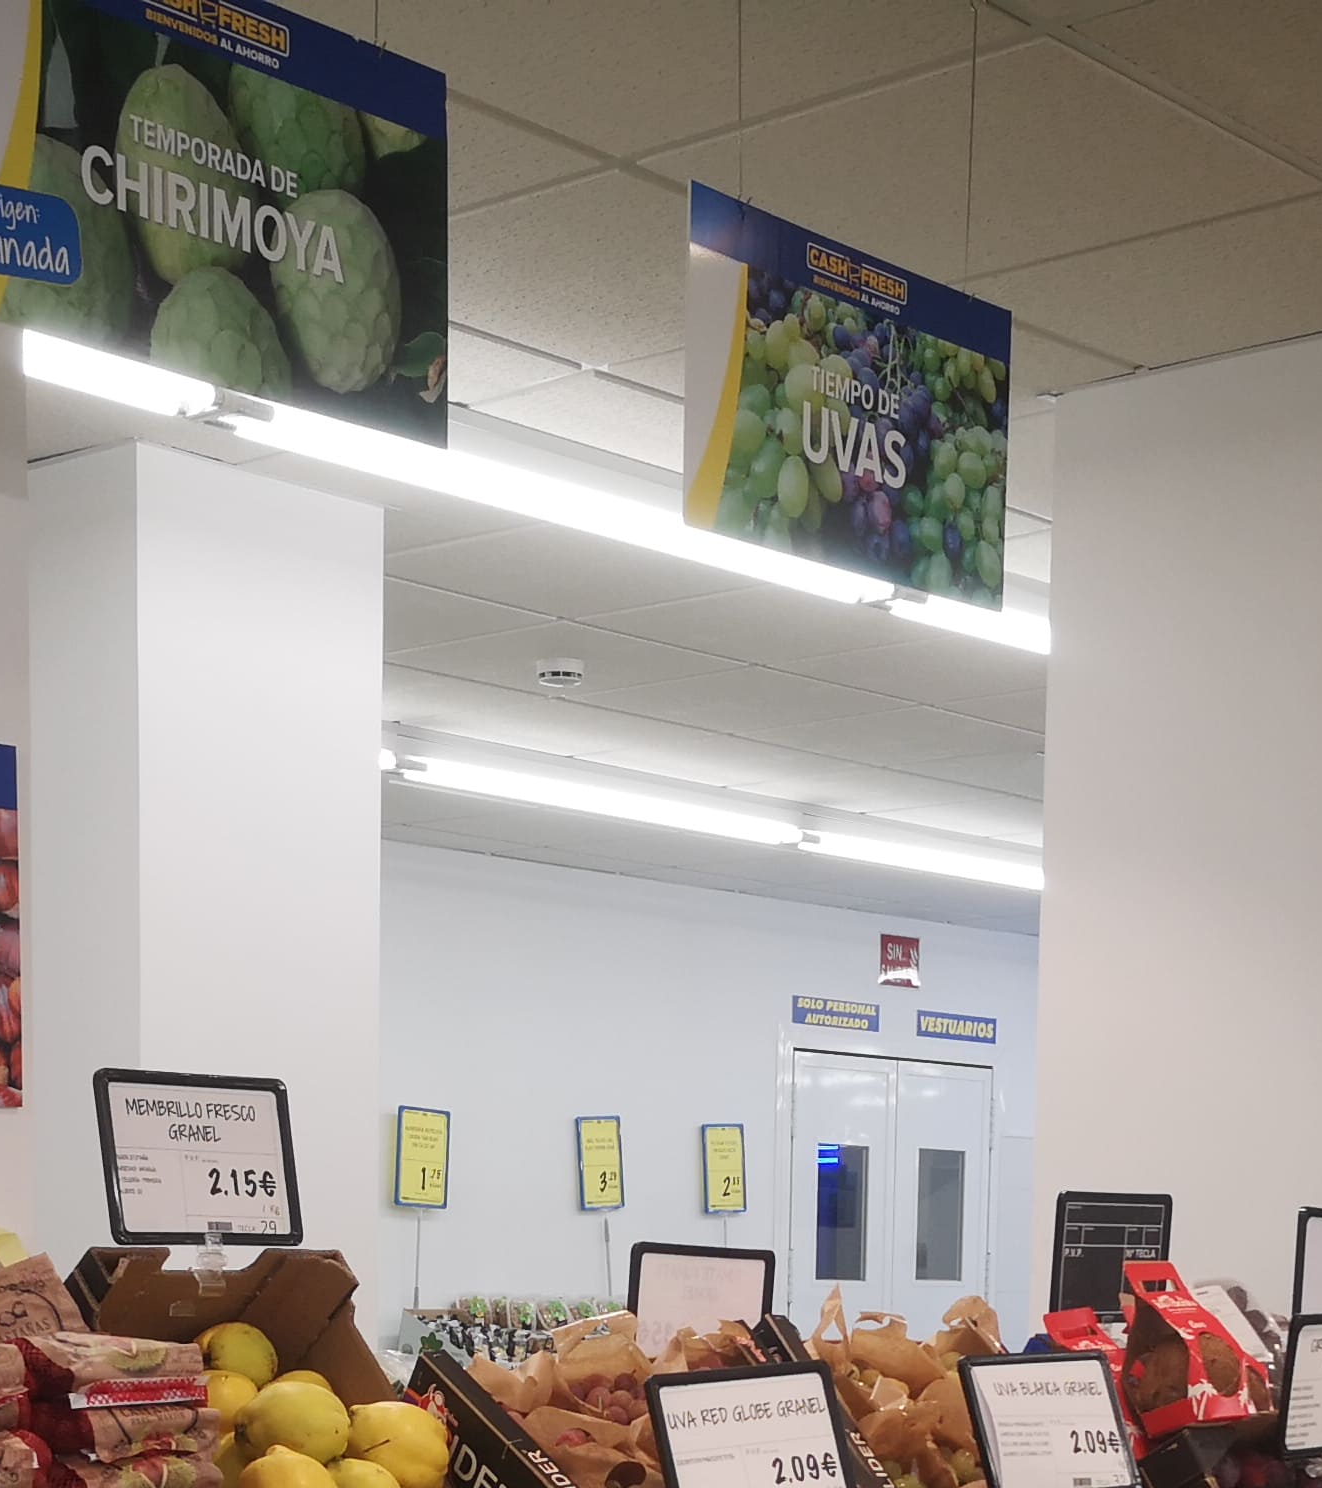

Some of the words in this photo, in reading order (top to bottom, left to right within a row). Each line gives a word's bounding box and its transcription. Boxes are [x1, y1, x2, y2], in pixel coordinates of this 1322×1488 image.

[145, 8, 218, 46] BIENVENIDOS
[220, 38, 233, 53] AL
[235, 44, 279, 69] AHORRO
[219, 7, 285, 51] FRESH
[130, 114, 265, 188] TEMPORADA
[271, 165, 298, 198] DE
[81, 144, 345, 285] CHIRIMOYA
[809, 247, 848, 282] CASH
[861, 267, 906, 301] FRESH
[813, 274, 860, 301] BIENVENIDOS
[861, 290, 870, 303] AL
[871, 293, 900, 315] AHORRO
[811, 366, 875, 412] TIEMPO
[877, 387, 900, 420] DE
[802, 400, 908, 489] UVAS
[886, 943, 902, 960] SIN
[796, 997, 824, 1011] SOLO
[826, 1001, 877, 1016] PERSONAL
[804, 1012, 869, 1030] AUTORIZADO
[919, 1015, 994, 1039] VESTUARIOS
[125, 1098, 203, 1119] MEMBRILLO
[206, 1103, 256, 1122] FRESCO
[168, 1123, 222, 1143] GRANEL
[208, 1168, 277, 1198] 2.15€
[992, 1381, 1018, 1396] UVA
[667, 1411, 698, 1433] UVA
[701, 1406, 729, 1427] RED
[732, 1401, 774, 1425] GLOBE
[776, 1396, 827, 1419] GRANEL
[1070, 1430, 1120, 1454] 2.09€
[772, 1452, 838, 1488] 2.09€
